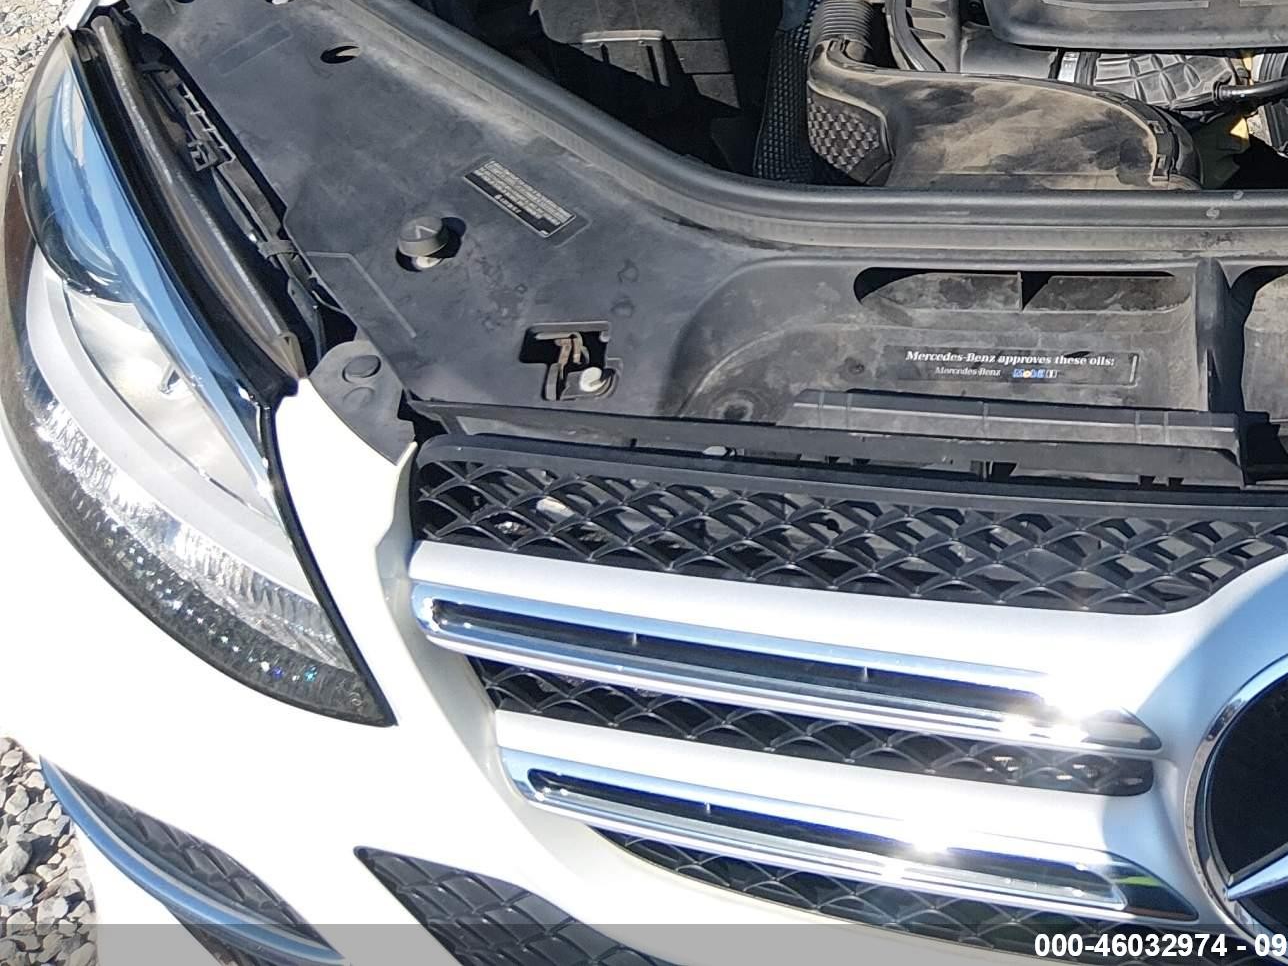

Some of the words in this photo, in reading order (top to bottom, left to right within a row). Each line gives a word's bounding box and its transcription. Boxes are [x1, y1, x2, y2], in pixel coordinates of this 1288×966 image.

[905, 350, 996, 363] Mercedes-Benz
[997, 354, 1051, 365] approves
[1055, 355, 1087, 365] these
[1089, 356, 1115, 366] oils:
